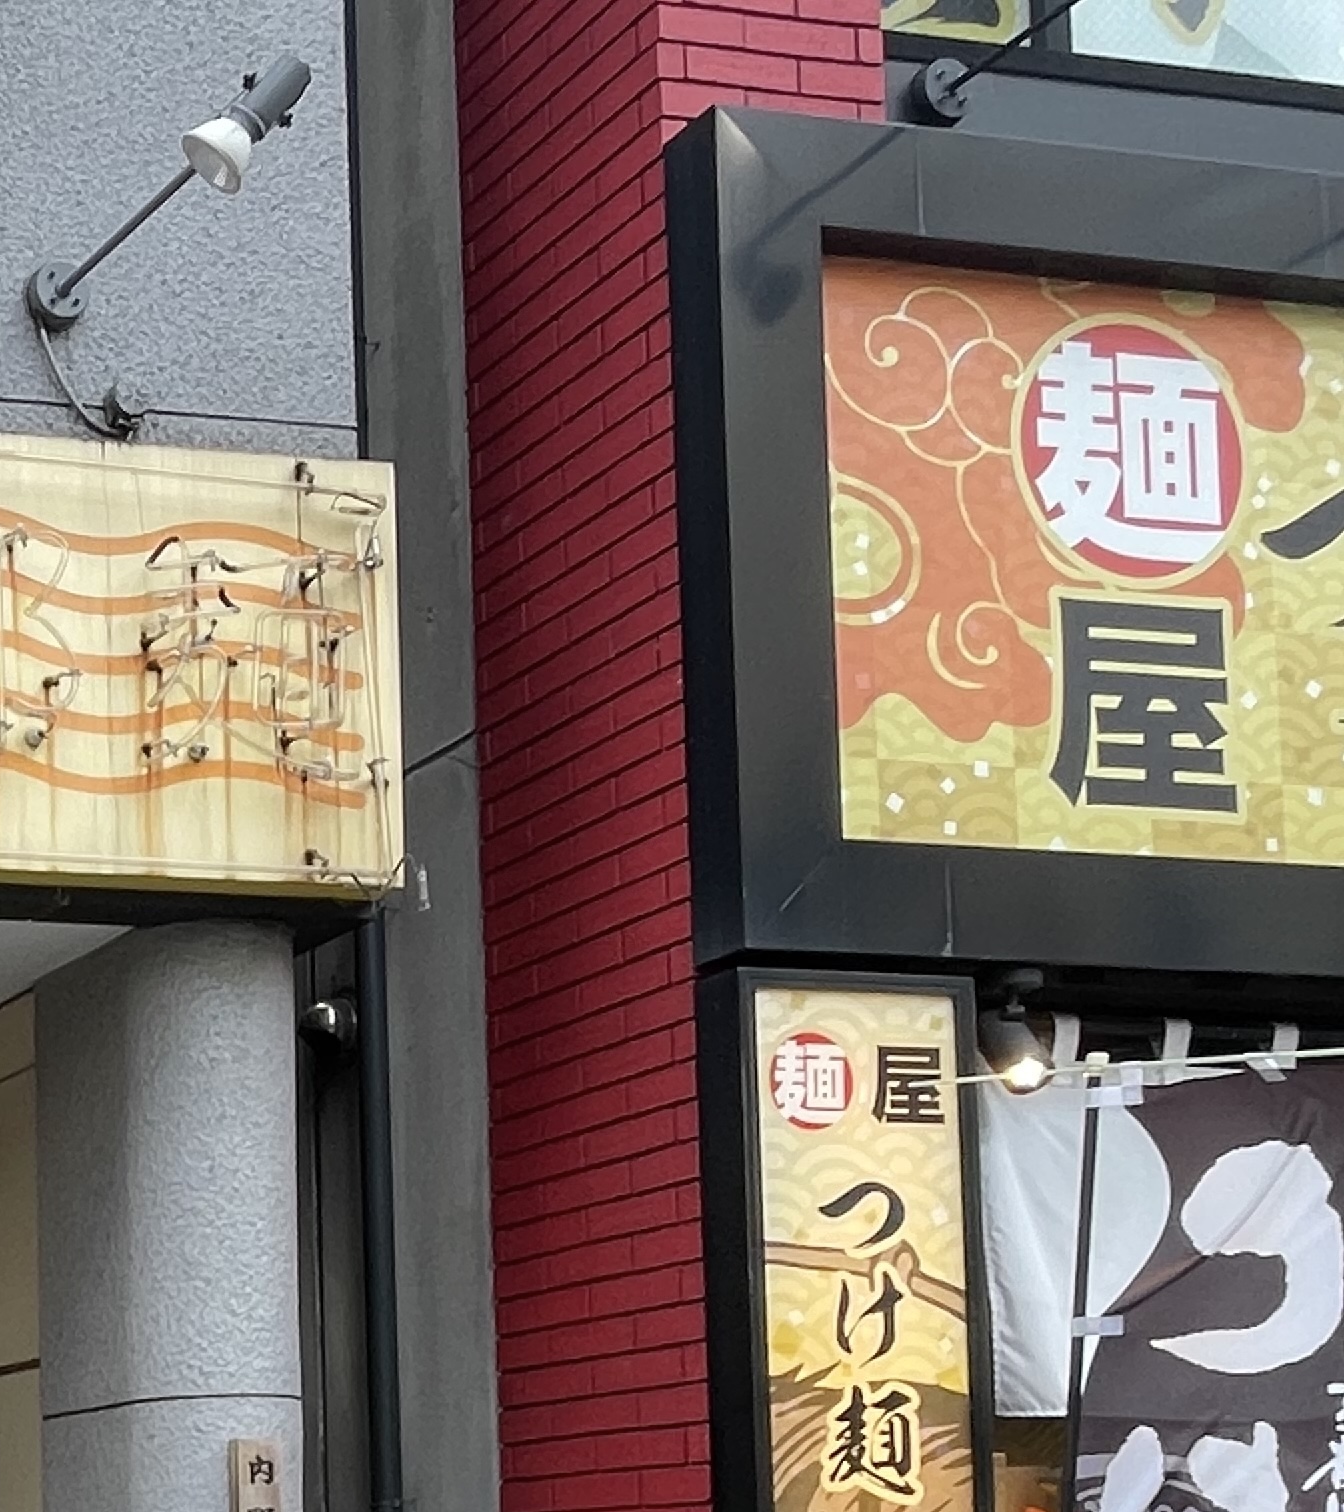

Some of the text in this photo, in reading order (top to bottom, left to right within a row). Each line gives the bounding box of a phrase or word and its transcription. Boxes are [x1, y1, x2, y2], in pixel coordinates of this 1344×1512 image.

[1034, 338, 1239, 810] 麺屋
[772, 1036, 946, 1127] 麺屋
[817, 1180, 917, 1497] つけ麺
